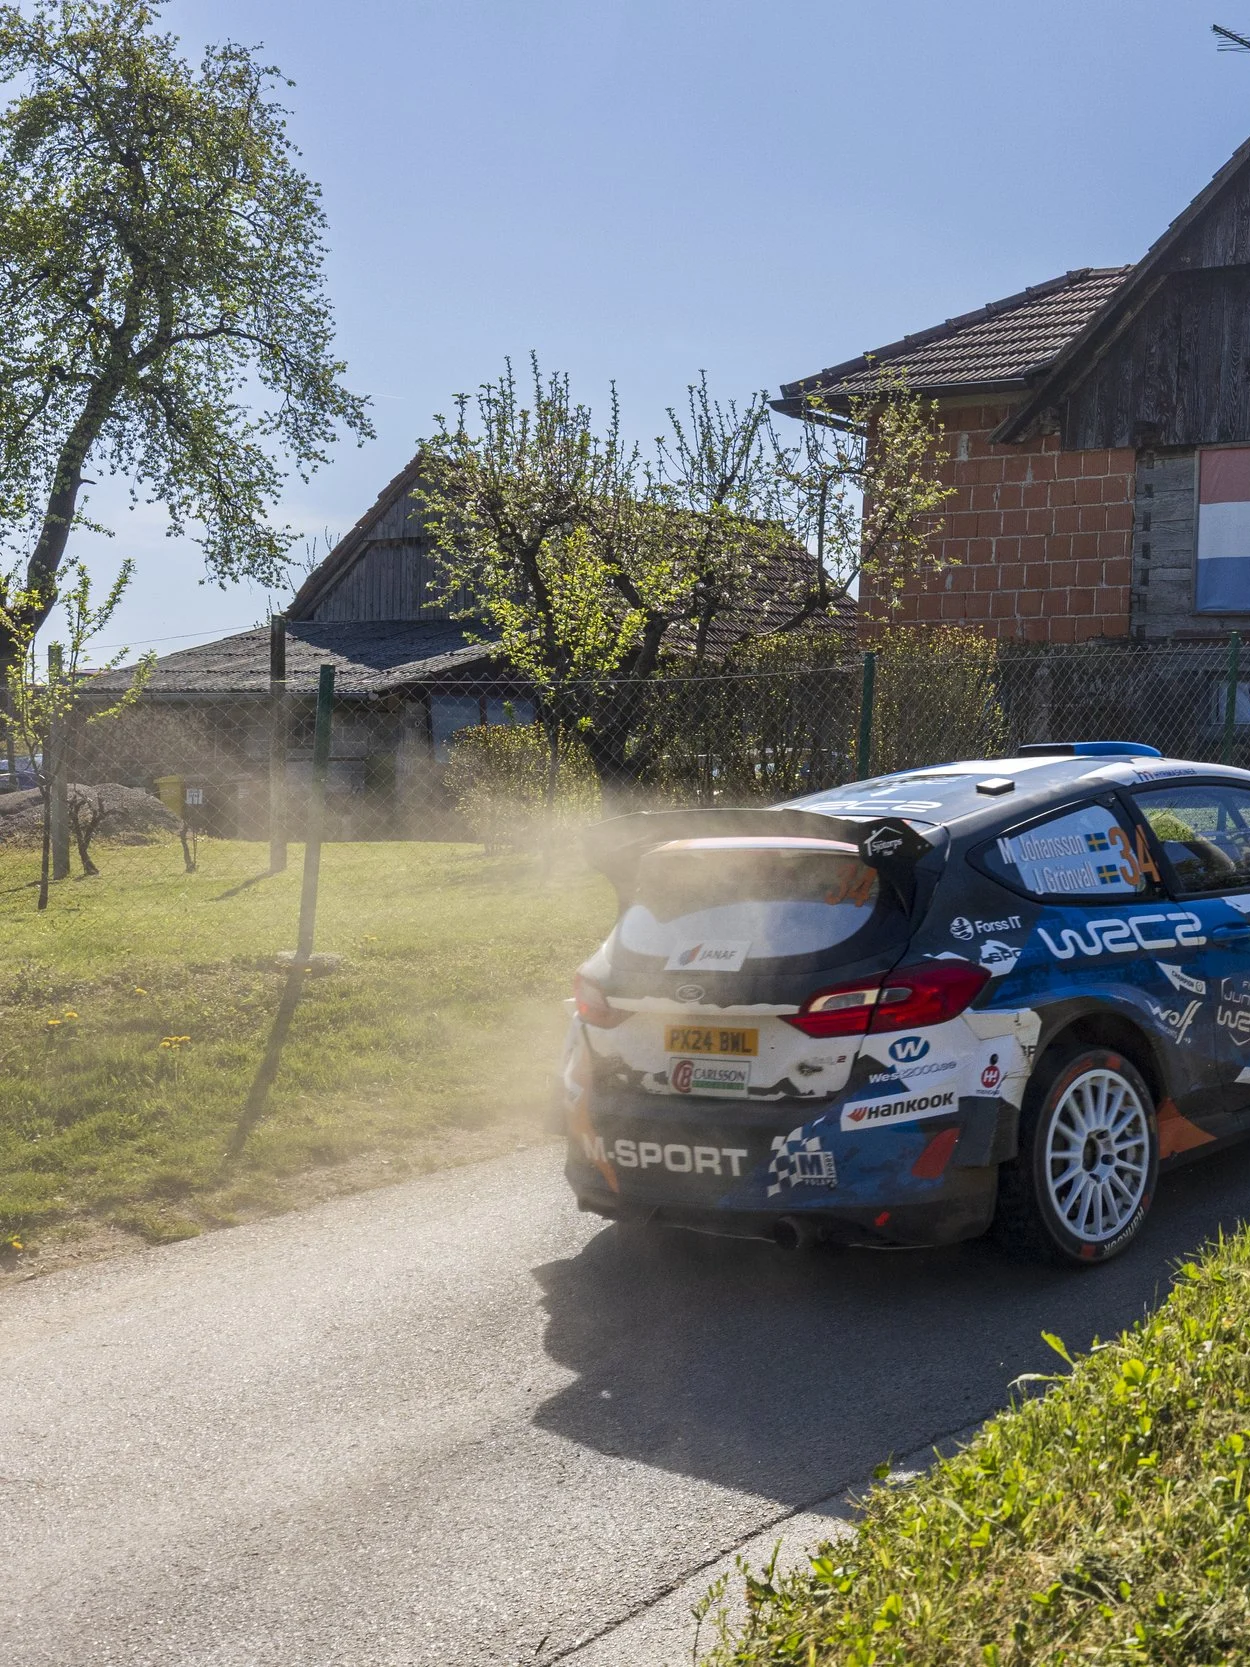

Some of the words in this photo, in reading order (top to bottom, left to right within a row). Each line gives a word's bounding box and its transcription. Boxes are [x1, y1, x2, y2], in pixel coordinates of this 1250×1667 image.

[996, 837, 1016, 865] M
[1018, 834, 1087, 863] Johansson
[1108, 824, 1161, 886] 34
[824, 864, 878, 908] 34
[1032, 868, 1045, 895] J
[1044, 861, 1098, 893] Grönvall
[974, 918, 1010, 935] Forss
[1011, 916, 1022, 929] IT
[1037, 912, 1207, 960] WRC2
[700, 950, 737, 961] JANAF
[670, 1029, 713, 1051] PX24
[693, 1068, 746, 1082] CARLSSON
[581, 1132, 748, 1177] M-SPORT
